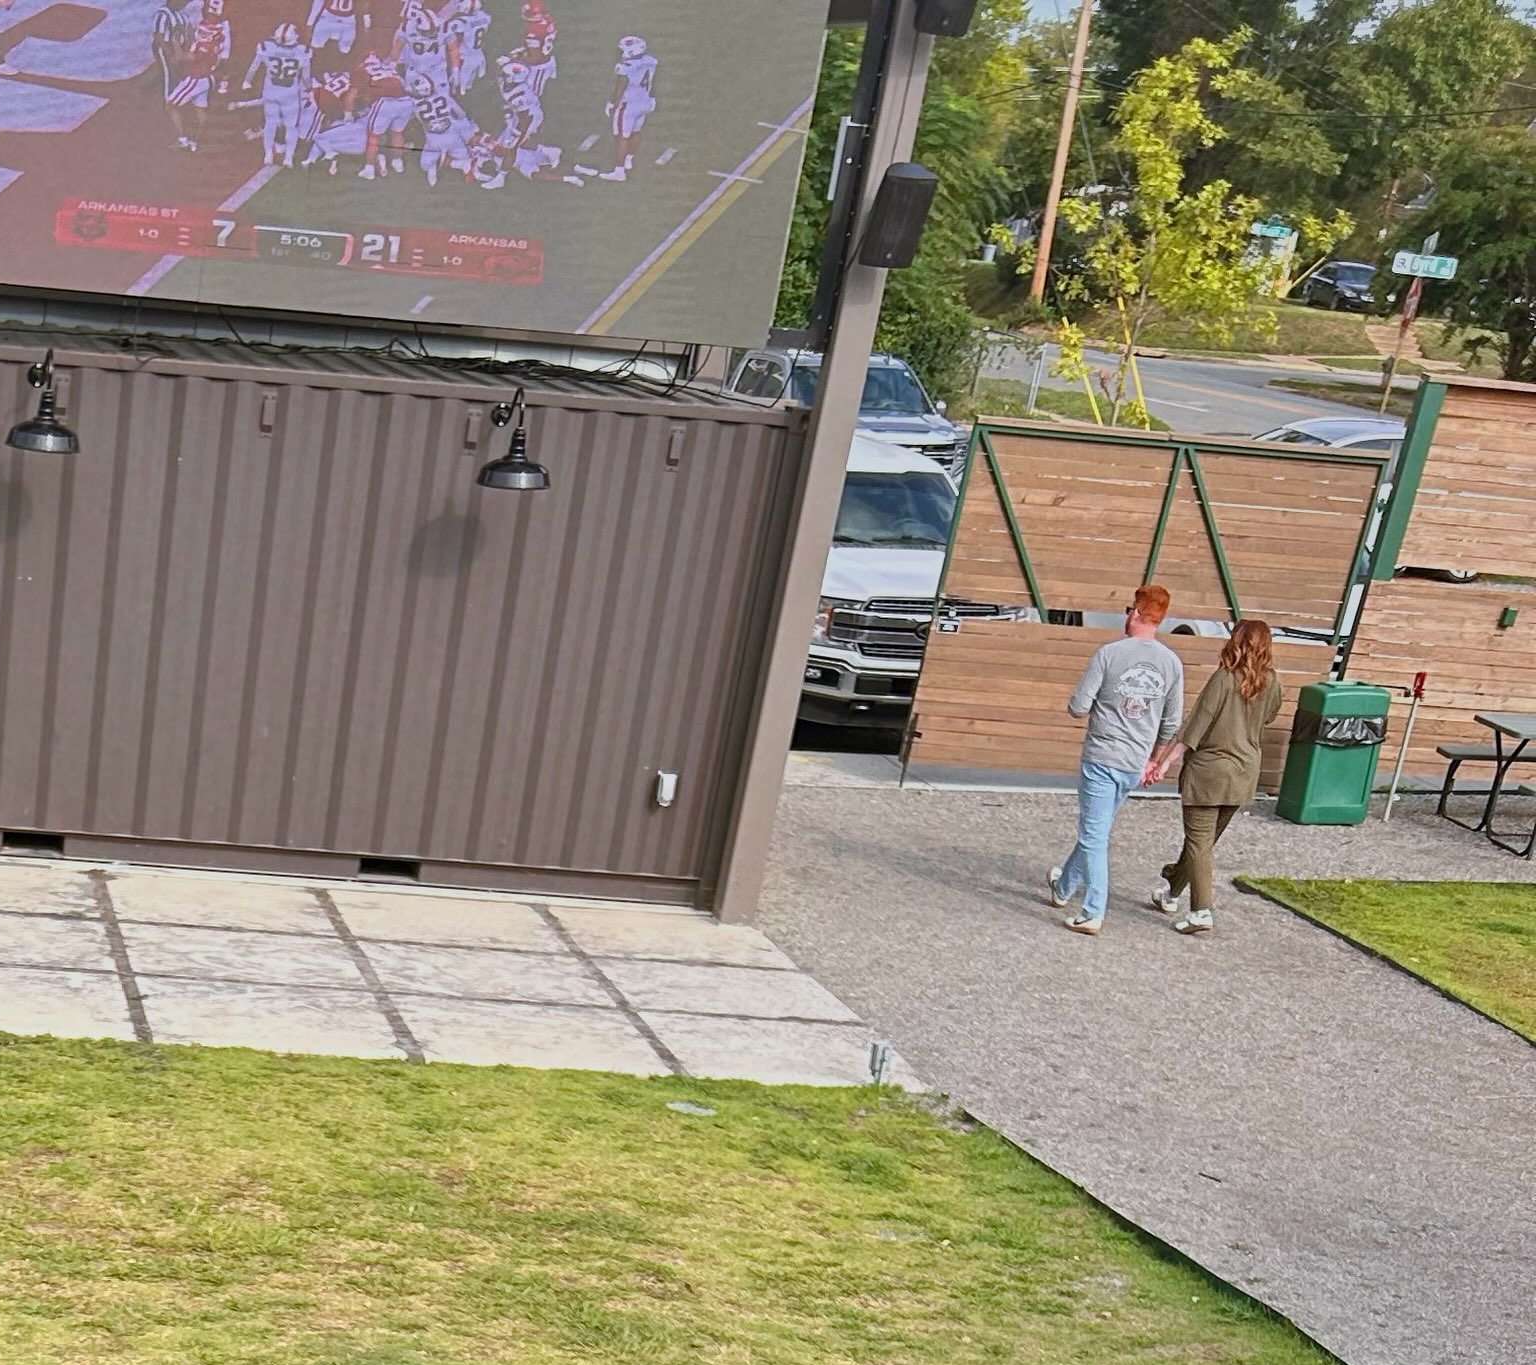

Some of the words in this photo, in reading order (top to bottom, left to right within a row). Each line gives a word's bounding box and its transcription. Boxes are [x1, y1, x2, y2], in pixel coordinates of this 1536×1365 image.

[268, 56, 300, 79] 32
[78, 201, 159, 217] ARKANSAS
[161, 207, 179, 218] ST
[212, 219, 236, 247] 7
[280, 234, 322, 248] 5:06
[448, 233, 529, 250] ARKANSAS
[360, 233, 401, 263] 21
